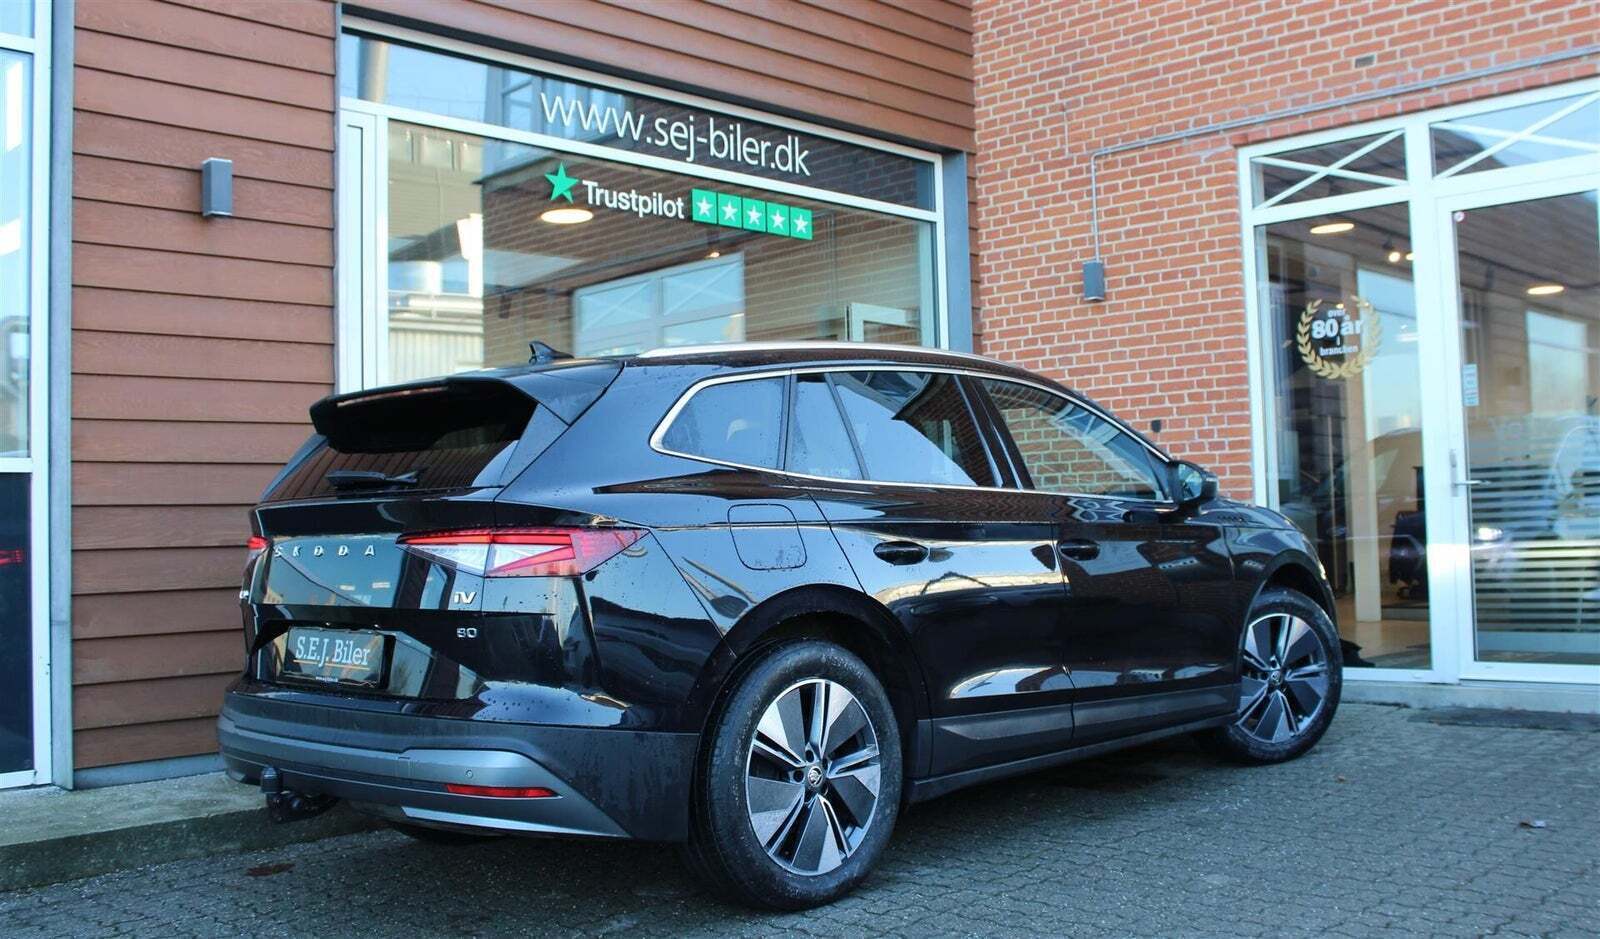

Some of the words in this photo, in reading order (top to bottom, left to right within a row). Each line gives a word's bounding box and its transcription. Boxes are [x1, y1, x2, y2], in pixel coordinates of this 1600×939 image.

[541, 92, 811, 176] www.sej-biler.dk
[582, 180, 685, 219] Trustpilot
[1311, 318, 1339, 339] 80
[295, 636, 329, 667] S.E.J.
[332, 640, 370, 666] Biler
